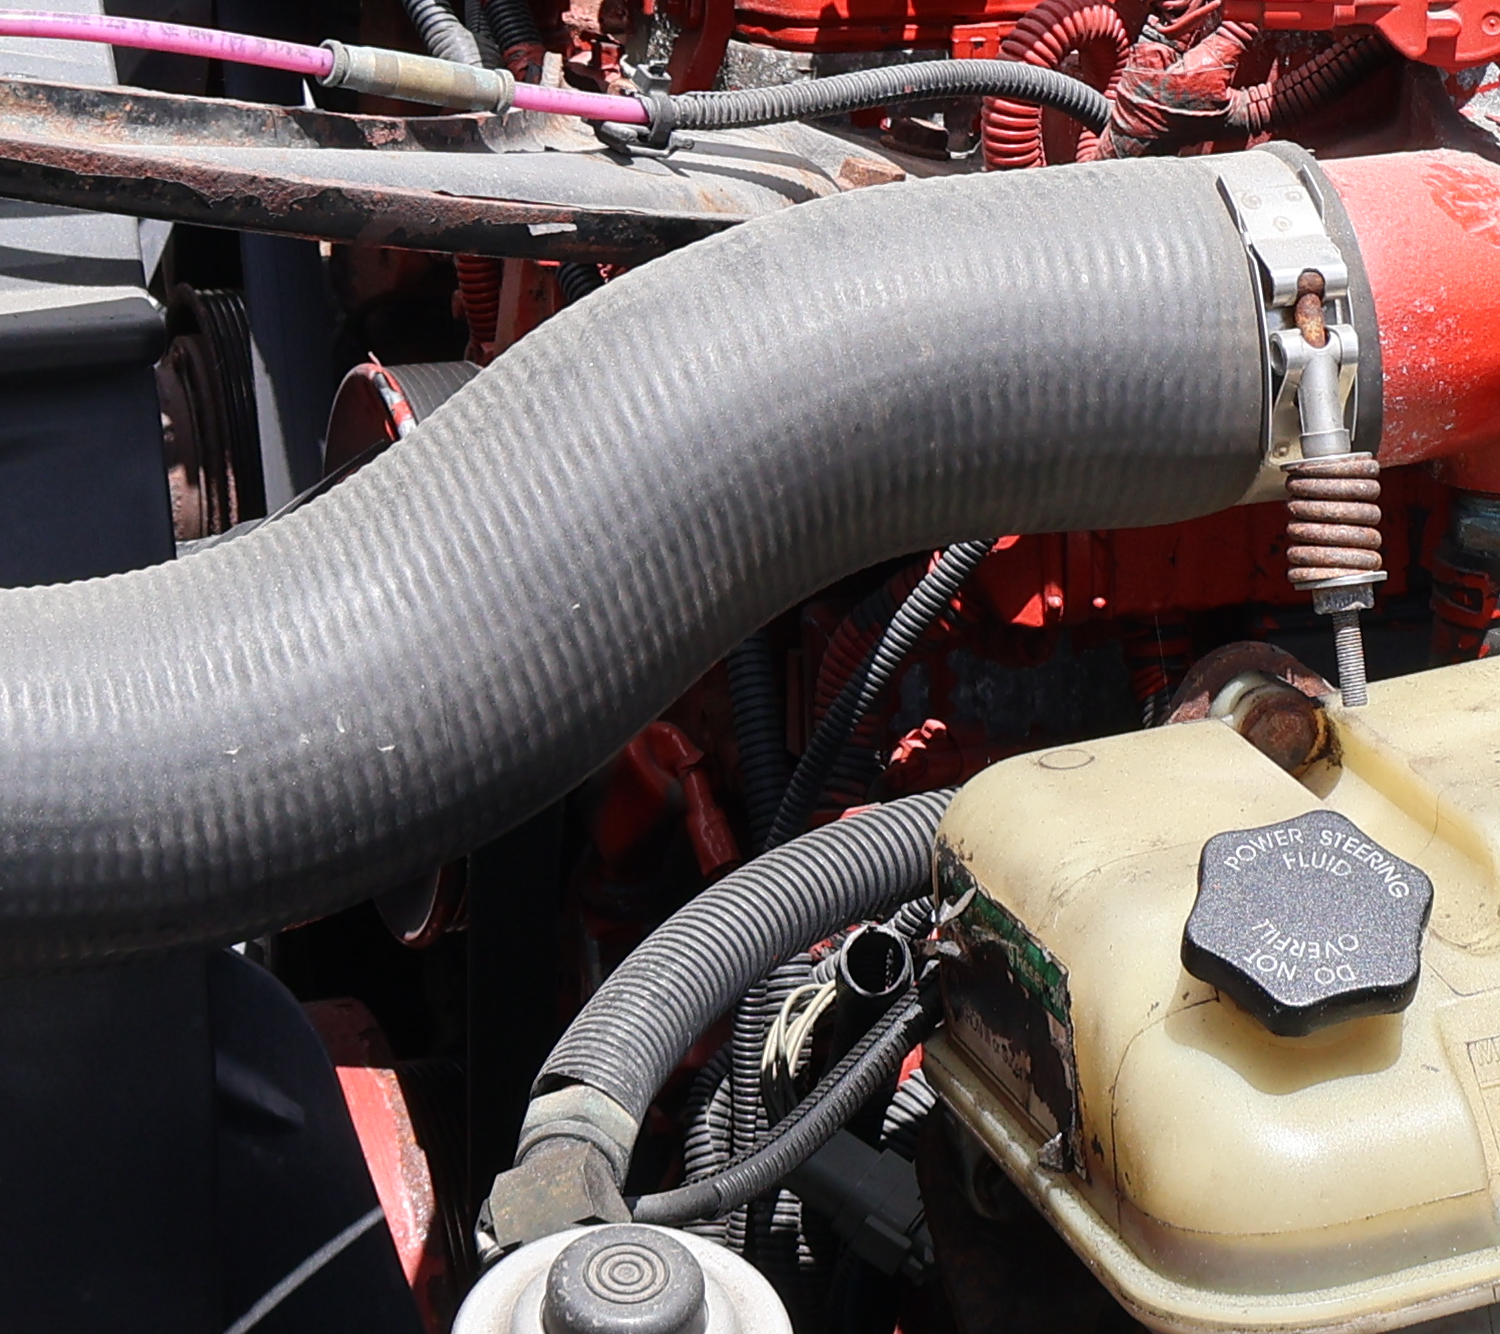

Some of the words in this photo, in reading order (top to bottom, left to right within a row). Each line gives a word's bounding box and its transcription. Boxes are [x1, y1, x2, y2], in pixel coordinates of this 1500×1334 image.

[1224, 828, 1303, 871] POWER
[1320, 830, 1409, 898] STEERING
[1283, 851, 1351, 877] FLUID
[1252, 918, 1359, 959] OVERFILL
[1244, 948, 1297, 980] NOT
[1314, 965, 1357, 985] DO
